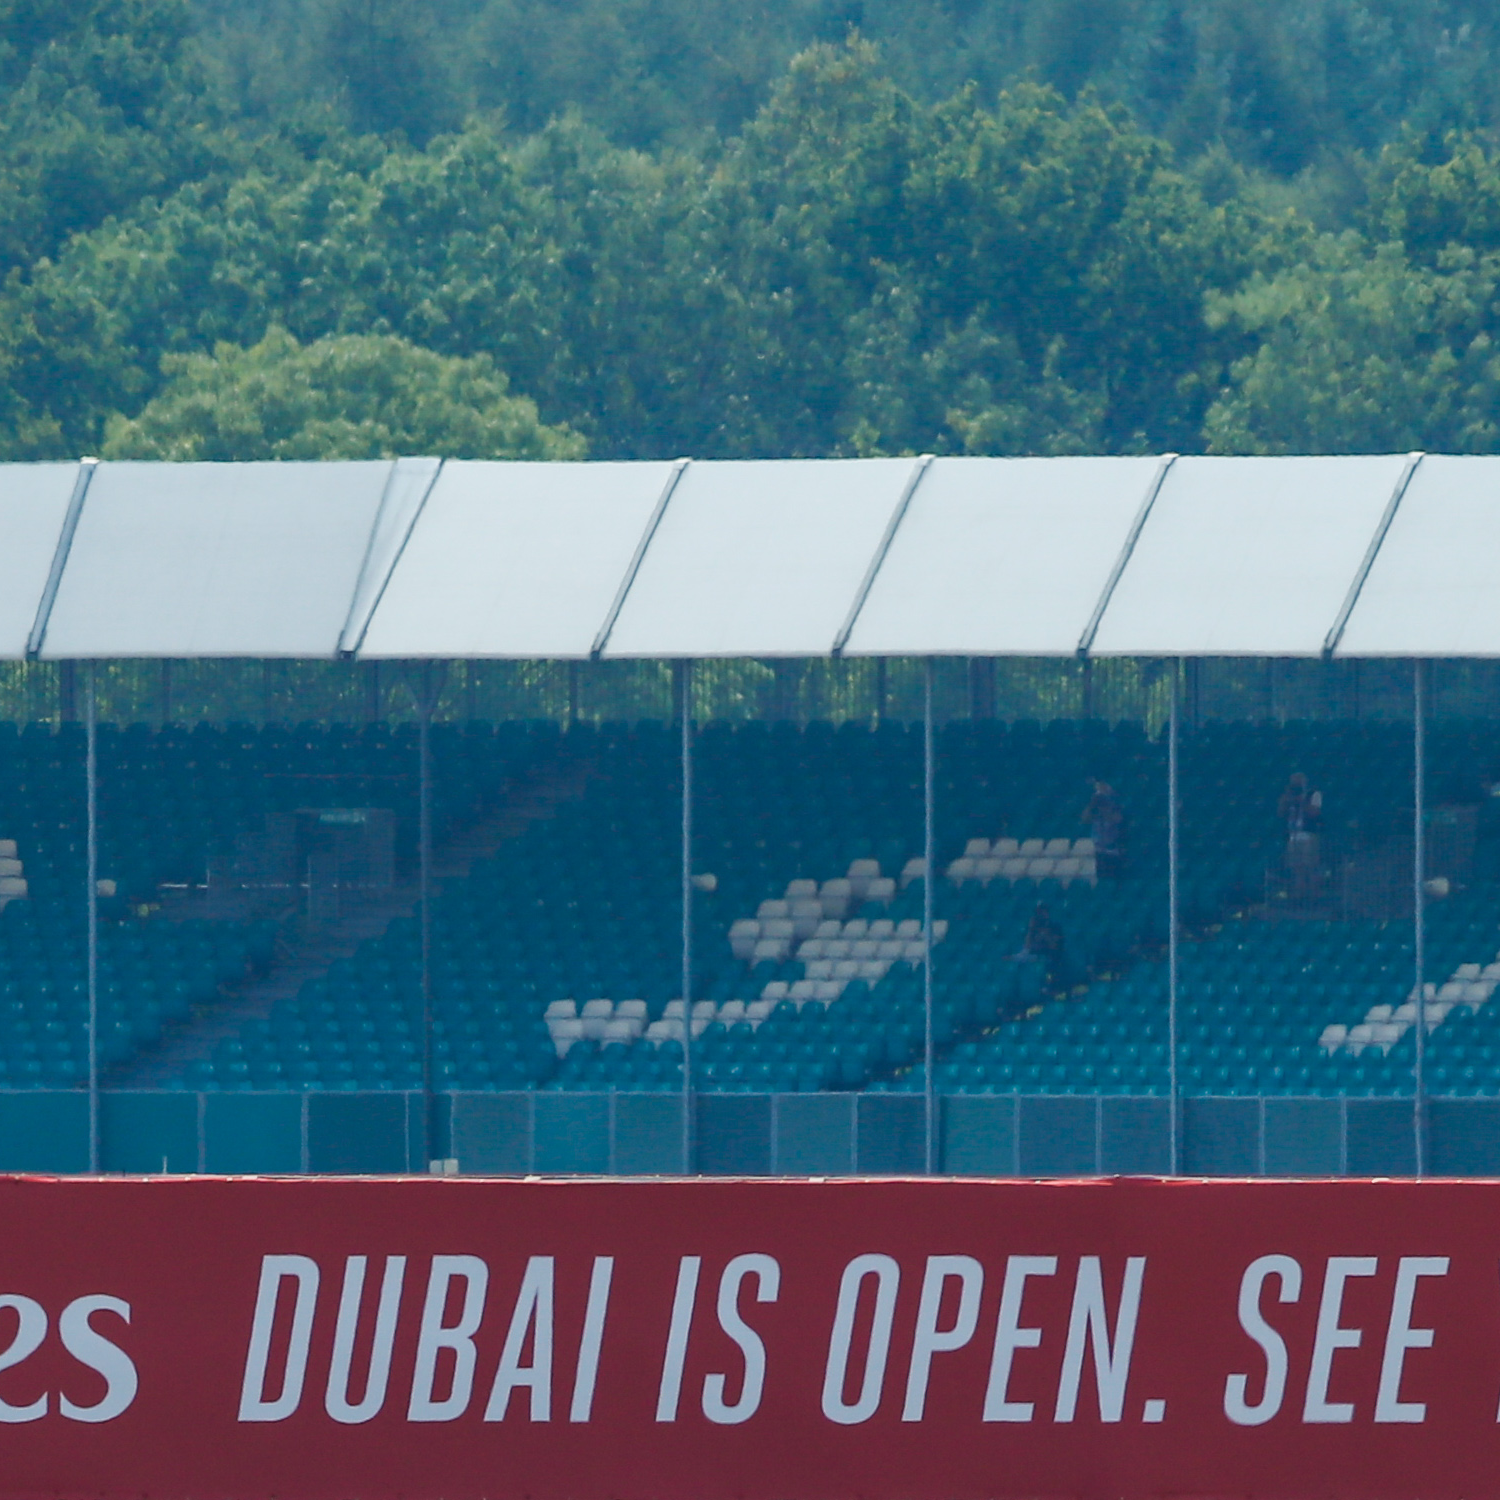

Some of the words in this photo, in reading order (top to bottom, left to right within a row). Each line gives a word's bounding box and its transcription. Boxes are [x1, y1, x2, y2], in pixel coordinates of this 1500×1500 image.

[237, 1255, 614, 1424] DUBAI
[655, 1253, 780, 1425] IS
[821, 1253, 1167, 1426] OPEN.
[1224, 1254, 1449, 1425] SEE
